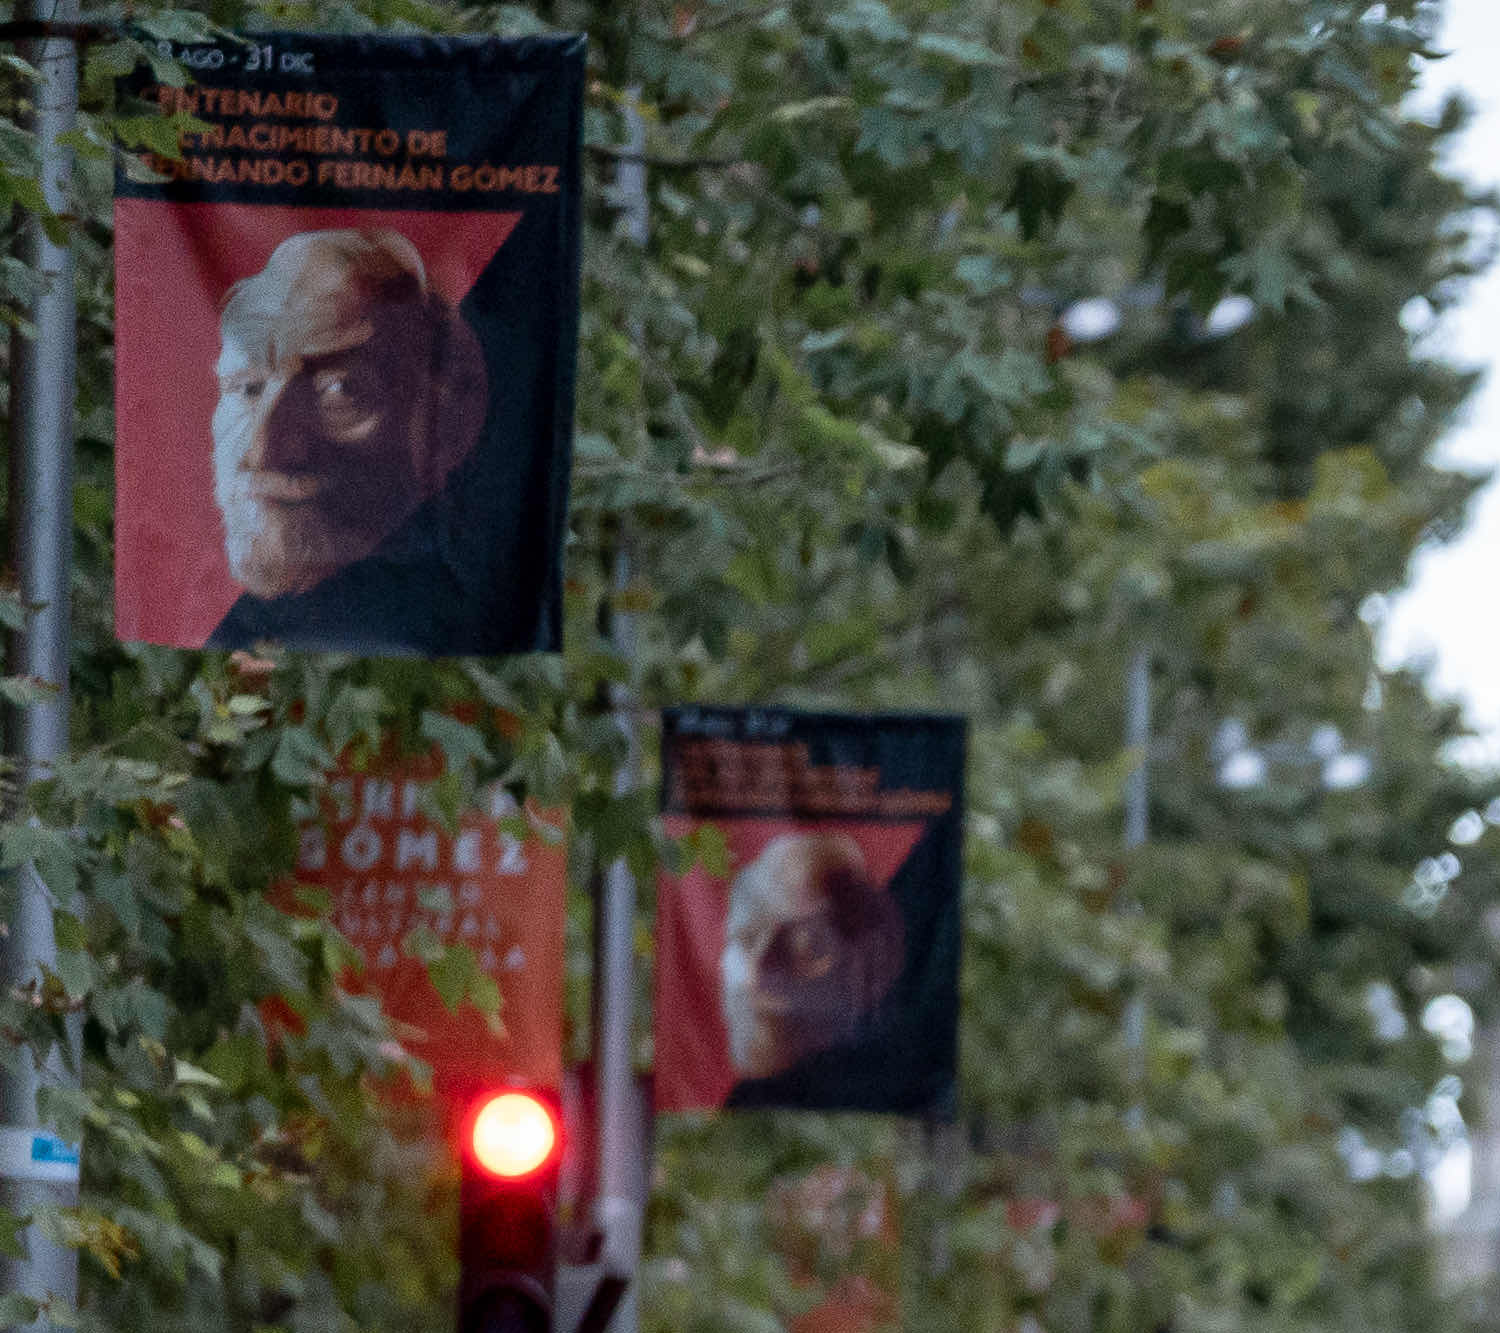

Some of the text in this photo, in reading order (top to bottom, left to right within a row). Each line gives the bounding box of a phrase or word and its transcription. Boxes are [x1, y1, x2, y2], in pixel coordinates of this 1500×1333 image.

[245, 43, 273, 71] 31
[282, 52, 315, 73] DIC
[407, 129, 449, 158] DE
[450, 161, 561, 194] GÓMEZ
